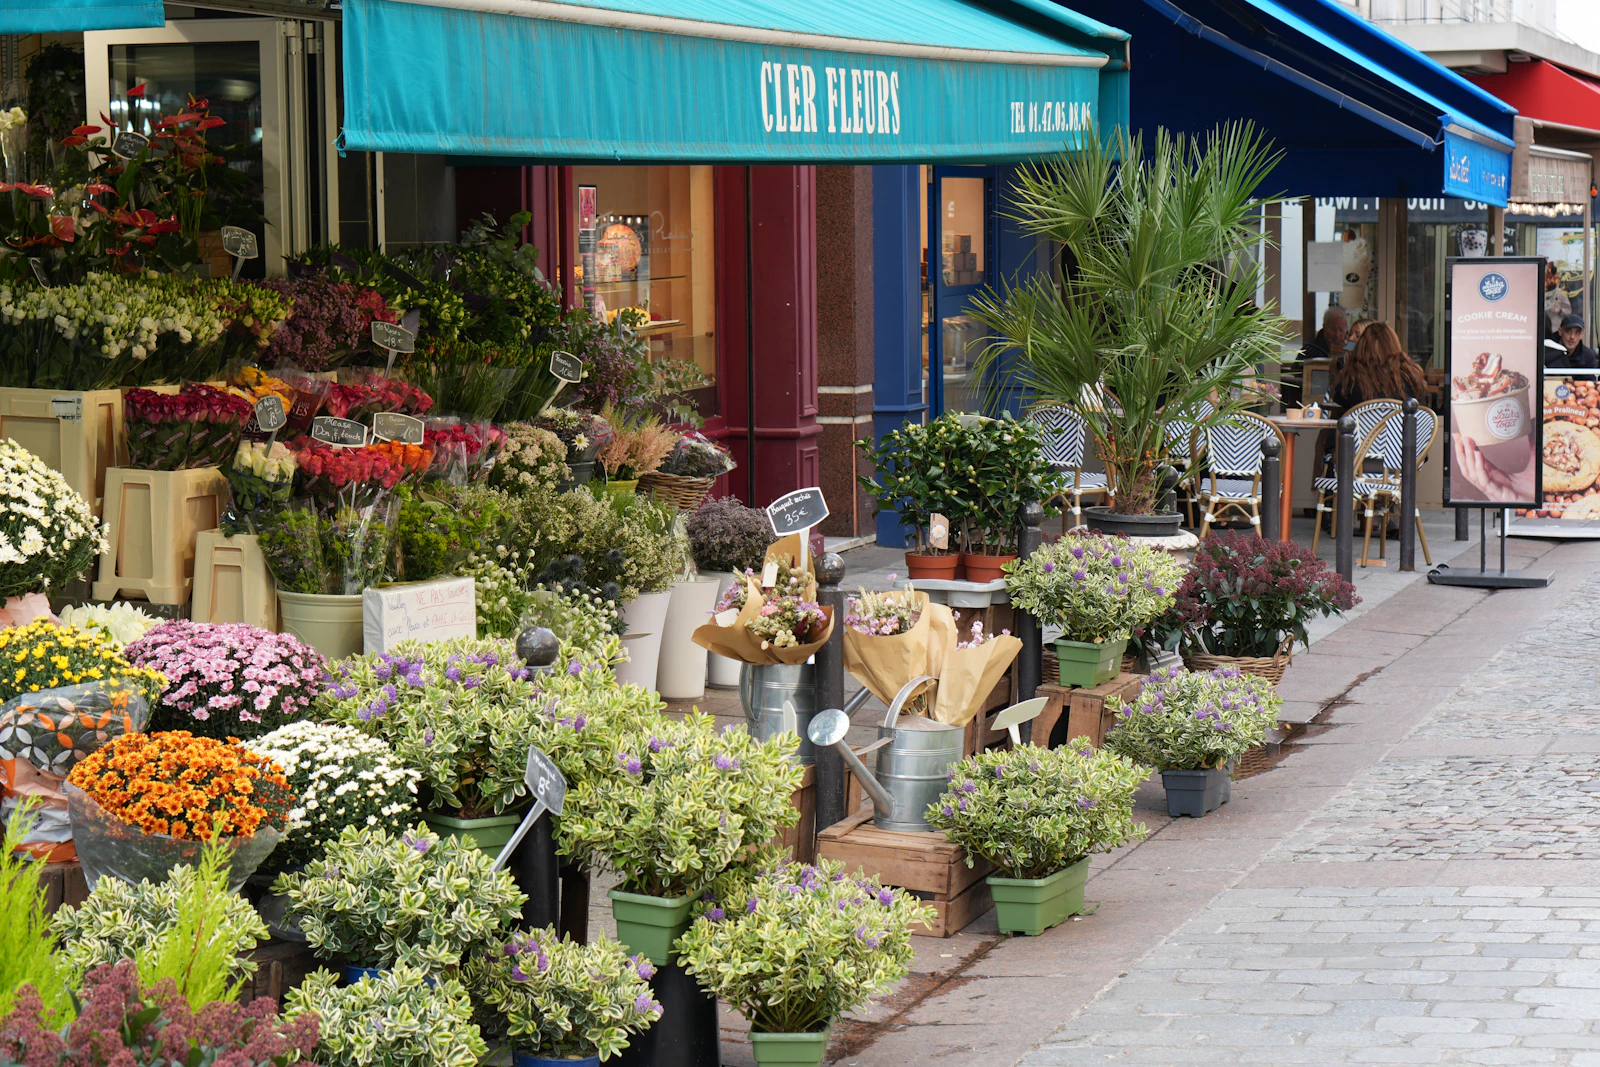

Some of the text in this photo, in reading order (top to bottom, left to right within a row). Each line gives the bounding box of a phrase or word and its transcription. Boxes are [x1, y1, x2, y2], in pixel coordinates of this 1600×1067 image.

[760, 61, 900, 135] CLER FLEURS
[1010, 101, 1026, 133] TEL
[1458, 311, 1528, 323] COOKIE CREAM
[324, 417, 352, 429] Please
[341, 428, 361, 440] touch
[770, 498, 794, 516] Bouquet
[784, 506, 808, 527] 35€
[415, 591, 427, 605] NE
[430, 588, 444, 605] PAS
[387, 625, 403, 638] aux
[422, 615, 430, 629] et
